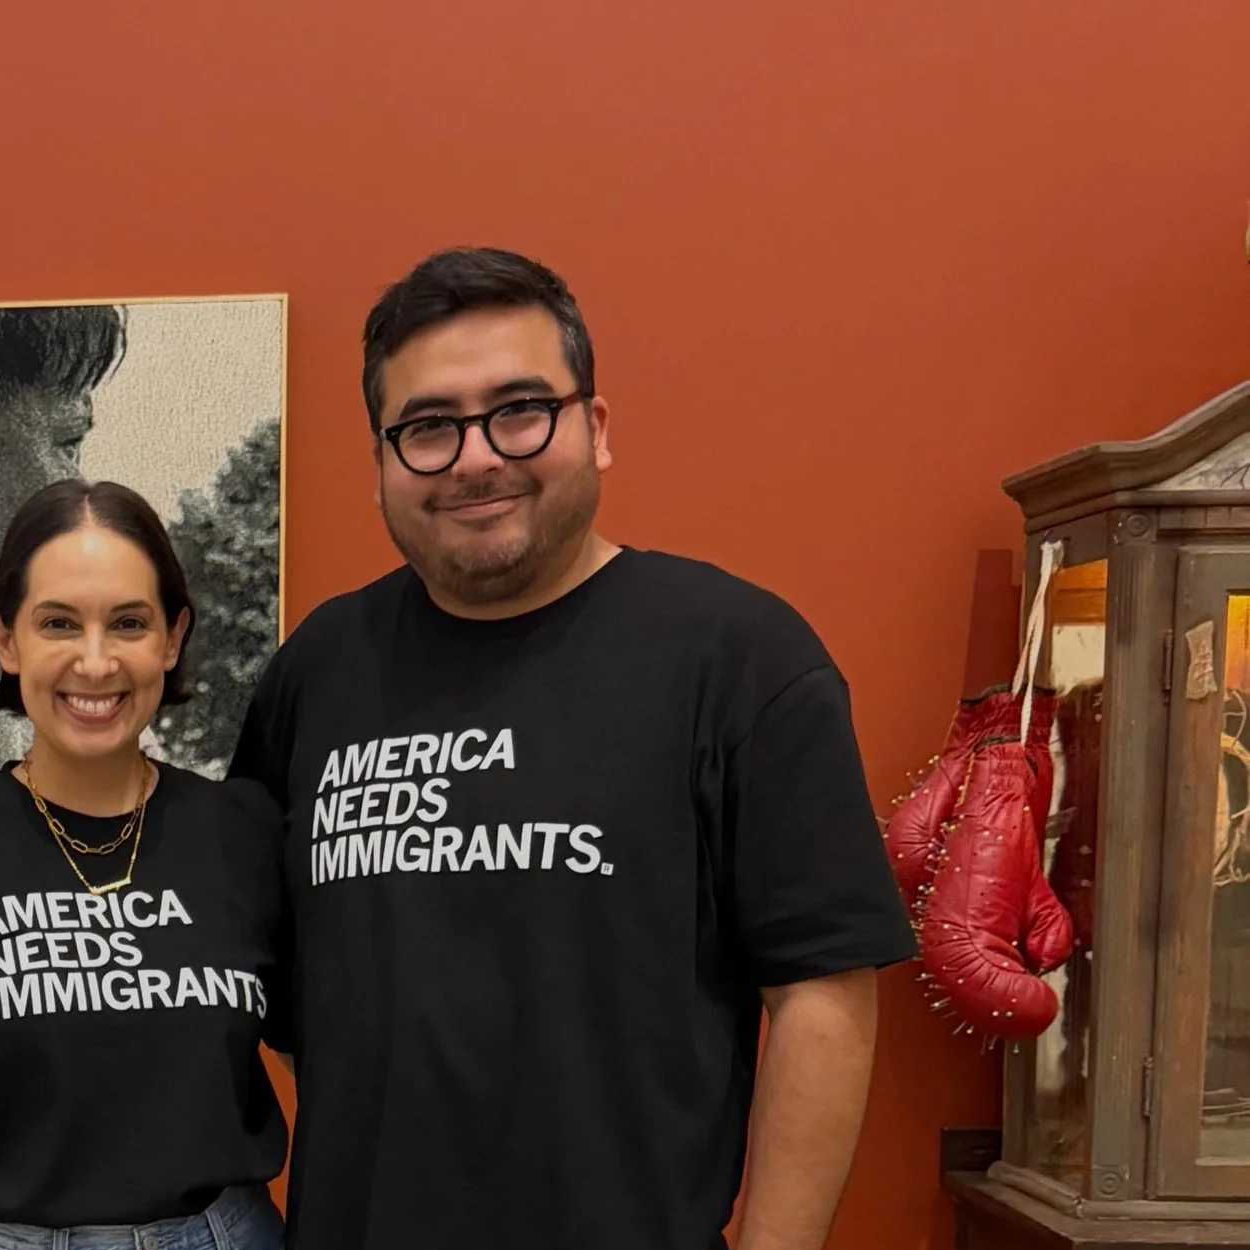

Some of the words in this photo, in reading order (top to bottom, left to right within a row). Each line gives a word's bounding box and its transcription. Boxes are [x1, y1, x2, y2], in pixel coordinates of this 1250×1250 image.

[317, 727, 516, 793] AMERICA
[311, 776, 451, 839] NEEDS
[310, 822, 615, 887] IMMIGRANTS.
